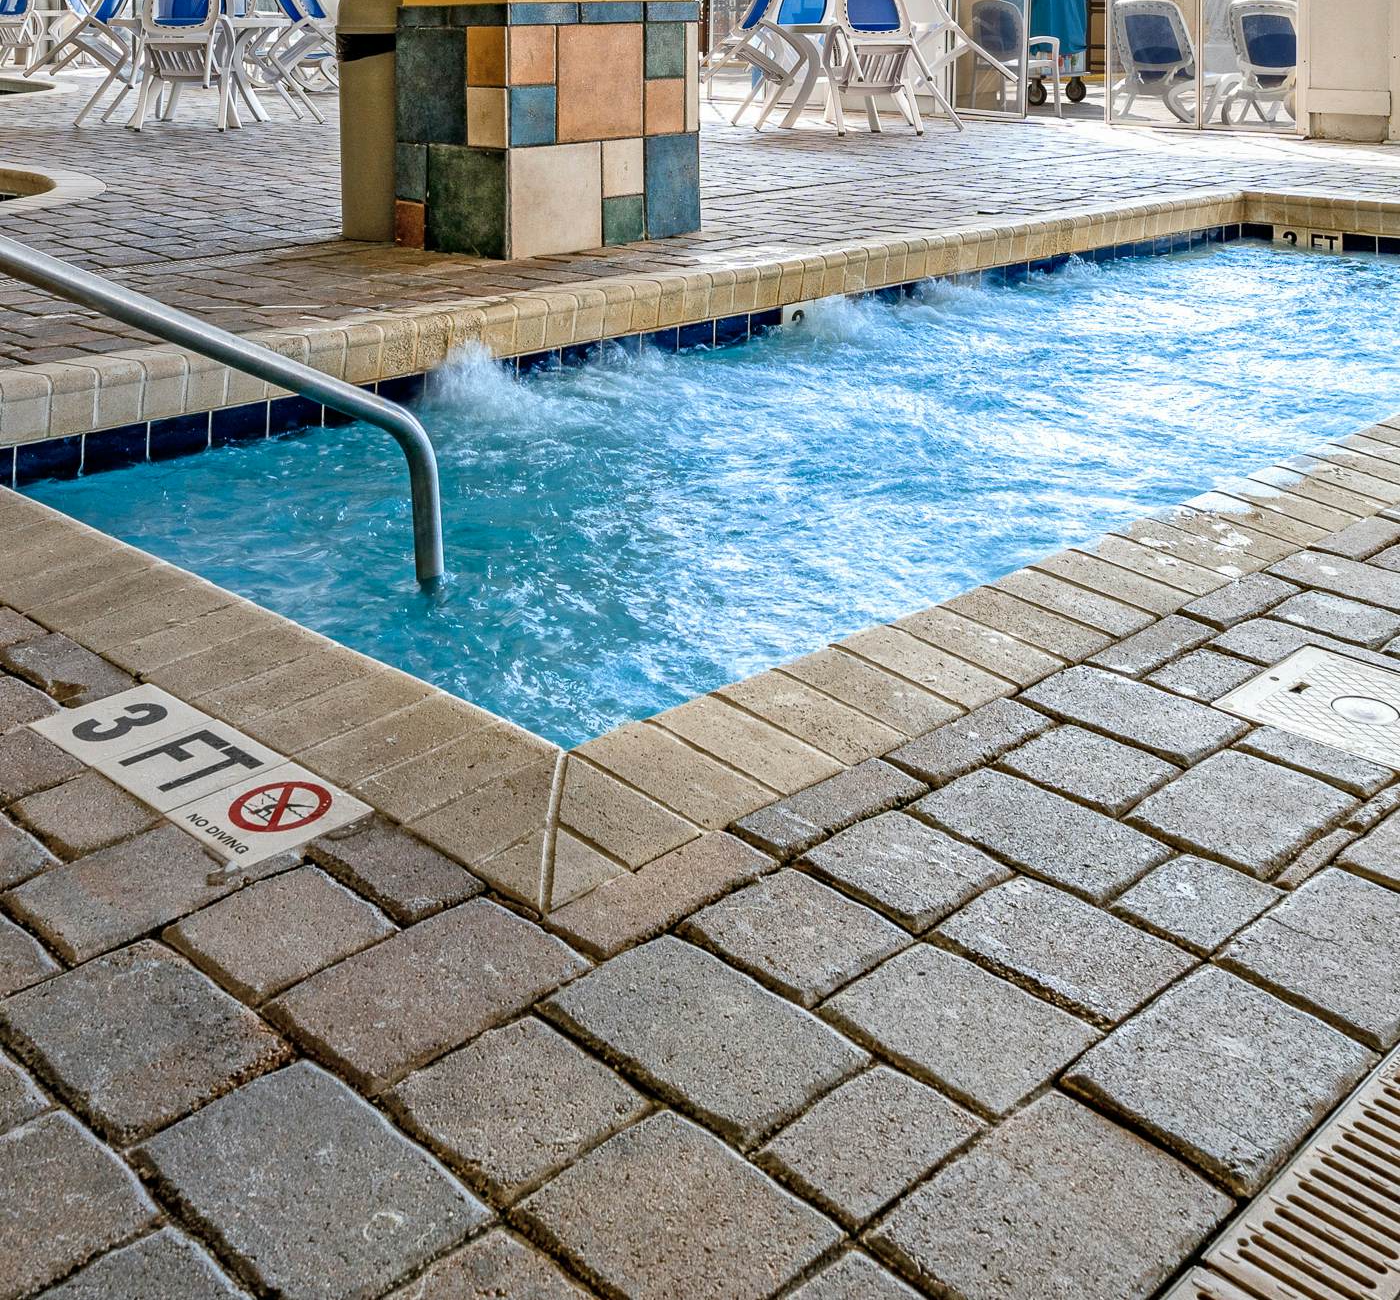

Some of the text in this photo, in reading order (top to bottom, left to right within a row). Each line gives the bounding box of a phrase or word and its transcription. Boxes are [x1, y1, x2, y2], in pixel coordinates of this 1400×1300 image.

[72, 703, 265, 793] 3 FT
[186, 813, 249, 855] NO DIVING
